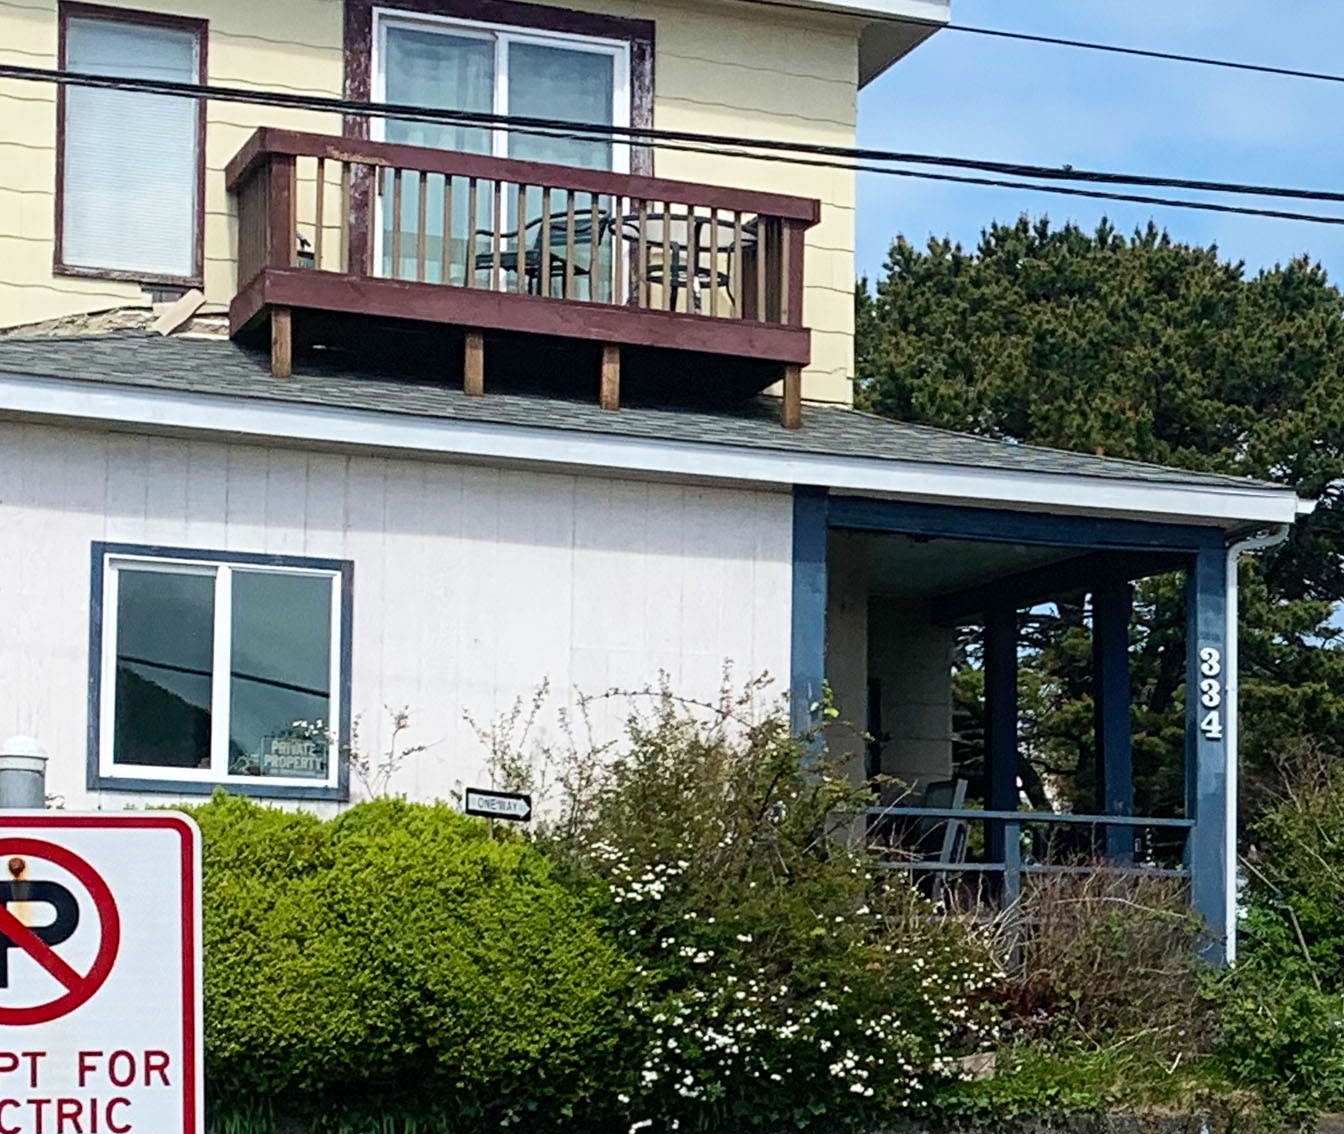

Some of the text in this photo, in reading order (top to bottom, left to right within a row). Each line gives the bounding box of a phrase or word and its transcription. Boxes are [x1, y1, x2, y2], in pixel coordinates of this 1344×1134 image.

[1200, 647, 1223, 739] 334
[271, 740, 316, 757] PRIVATE
[477, 797, 497, 810] ONE
[78, 1050, 171, 1087] FOR
